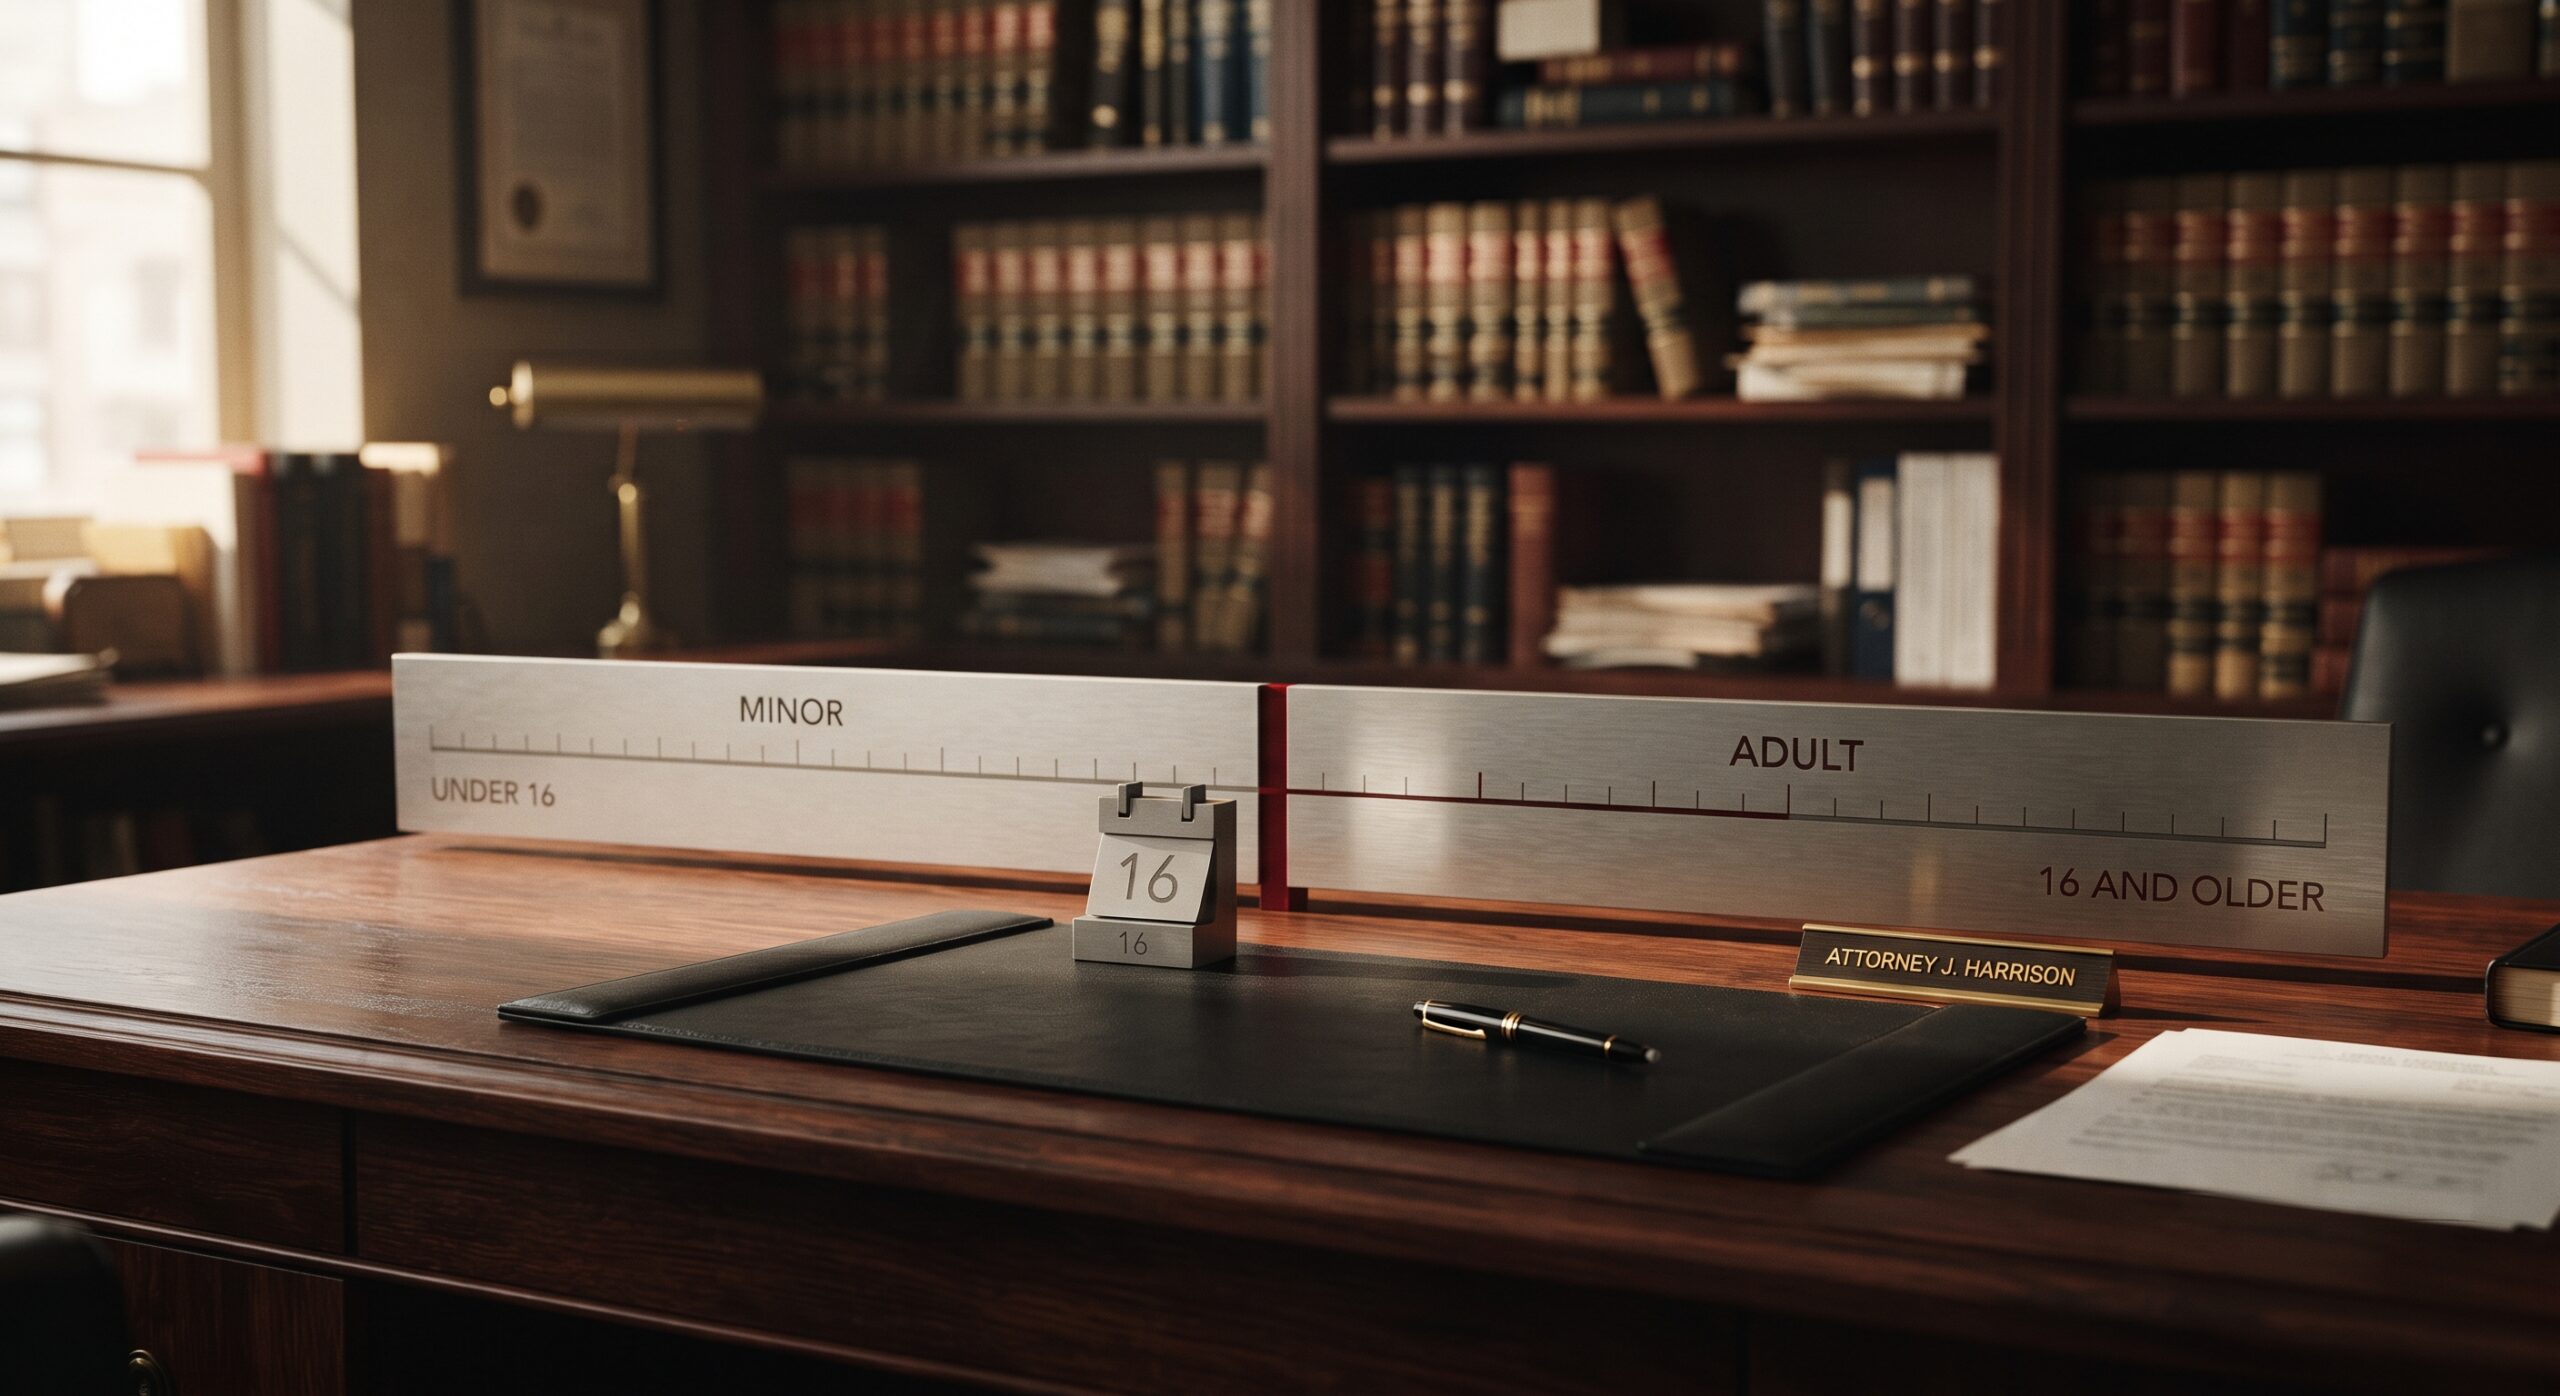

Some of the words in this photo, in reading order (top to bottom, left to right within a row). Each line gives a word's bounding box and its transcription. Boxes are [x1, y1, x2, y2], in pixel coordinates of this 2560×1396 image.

[740, 696, 843, 726] MINOR
[1729, 735, 1864, 772] ADULT
[431, 777, 519, 805] UNDER
[528, 782, 556, 807] 16
[1120, 852, 1178, 903] 16
[2040, 866, 2080, 897] 16
[2091, 870, 2178, 903] AND
[2192, 875, 2325, 912] OLDER
[1119, 931, 1148, 956] 16
[1825, 947, 1939, 974] ATTORNEY
[1941, 956, 1958, 977] J.
[1963, 959, 2077, 987] HARRISON
